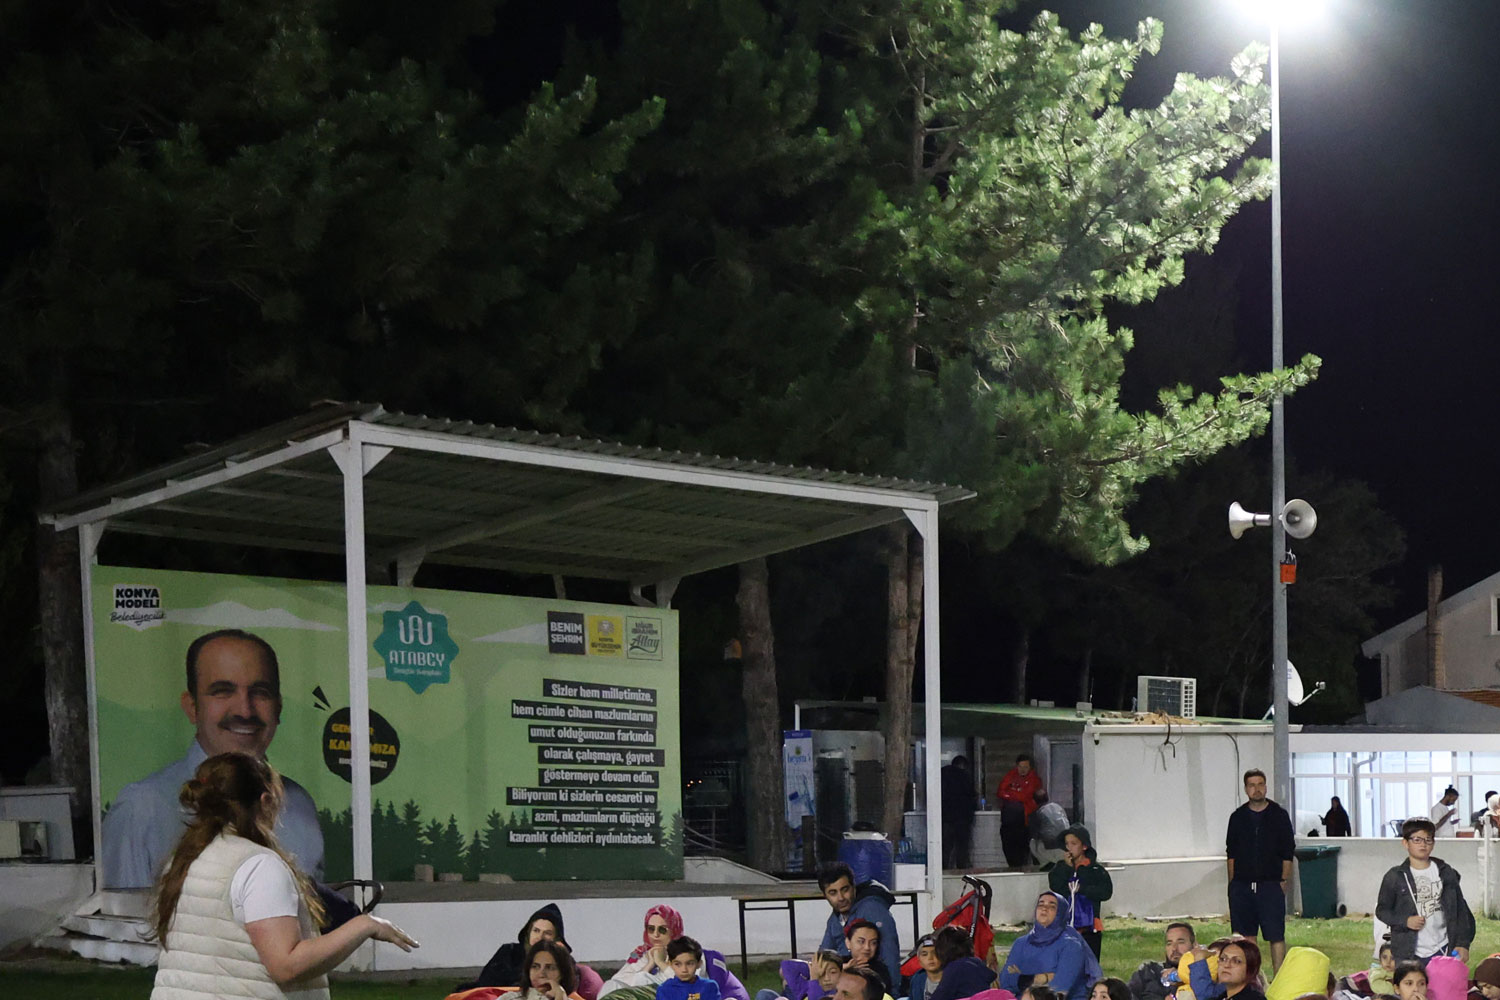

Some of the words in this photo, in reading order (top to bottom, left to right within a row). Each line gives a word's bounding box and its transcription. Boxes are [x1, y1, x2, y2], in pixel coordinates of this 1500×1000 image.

[115, 588, 160, 598] KONYA
[389, 650, 445, 667] ATABEY
[551, 683, 578, 697] Sizler
[579, 686, 600, 699] hem
[601, 687, 654, 703] milletimize,
[512, 703, 535, 716] hem
[535, 705, 566, 718] cümle
[567, 706, 593, 719] cihan
[594, 708, 654, 723] mazlumlarına
[530, 727, 556, 738] umut
[557, 727, 616, 743] olduğunuzun
[616, 729, 654, 743] farkında
[543, 747, 574, 760] olarak
[575, 748, 625, 765] çalışmaya,
[625, 751, 655, 766] gayret
[543, 769, 600, 785] göstermeye
[601, 770, 632, 783] devam
[632, 771, 655, 784] edin.
[511, 787, 558, 804] Biliyorum
[558, 789, 569, 800] ki
[569, 789, 604, 802] sizlerin
[605, 791, 643, 804] cesareti
[643, 794, 656, 804] ve
[534, 810, 561, 824] azmi,
[561, 811, 618, 824] mazlumların
[619, 812, 656, 828] düştüğü
[509, 831, 549, 843] karanlık
[550, 831, 594, 844] dehlizleri
[595, 832, 656, 847] aydınlatacak.
